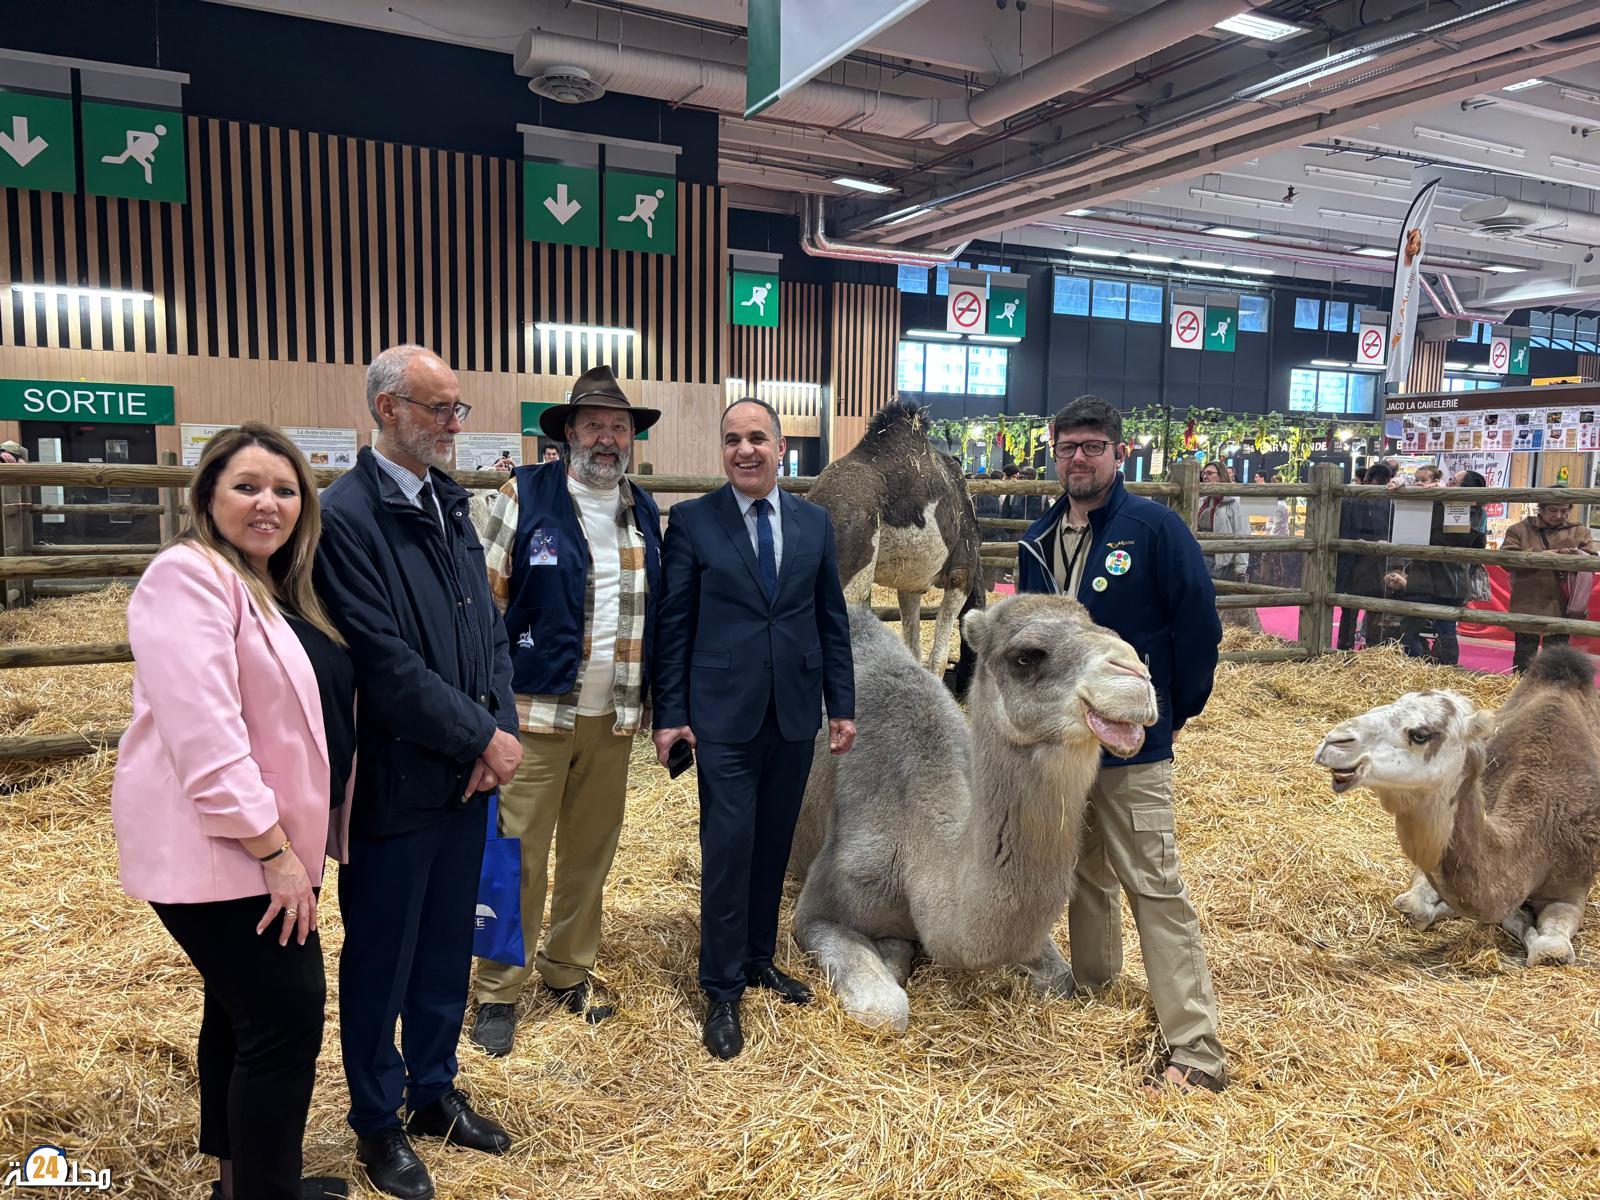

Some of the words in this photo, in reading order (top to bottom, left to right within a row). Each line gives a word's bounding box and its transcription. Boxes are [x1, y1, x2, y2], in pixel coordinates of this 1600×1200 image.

[24, 388, 147, 416] SORTIE
[1386, 401, 1405, 411] JACO
[1406, 401, 1416, 410] LA
[1417, 398, 1459, 409] CAMELERIE
